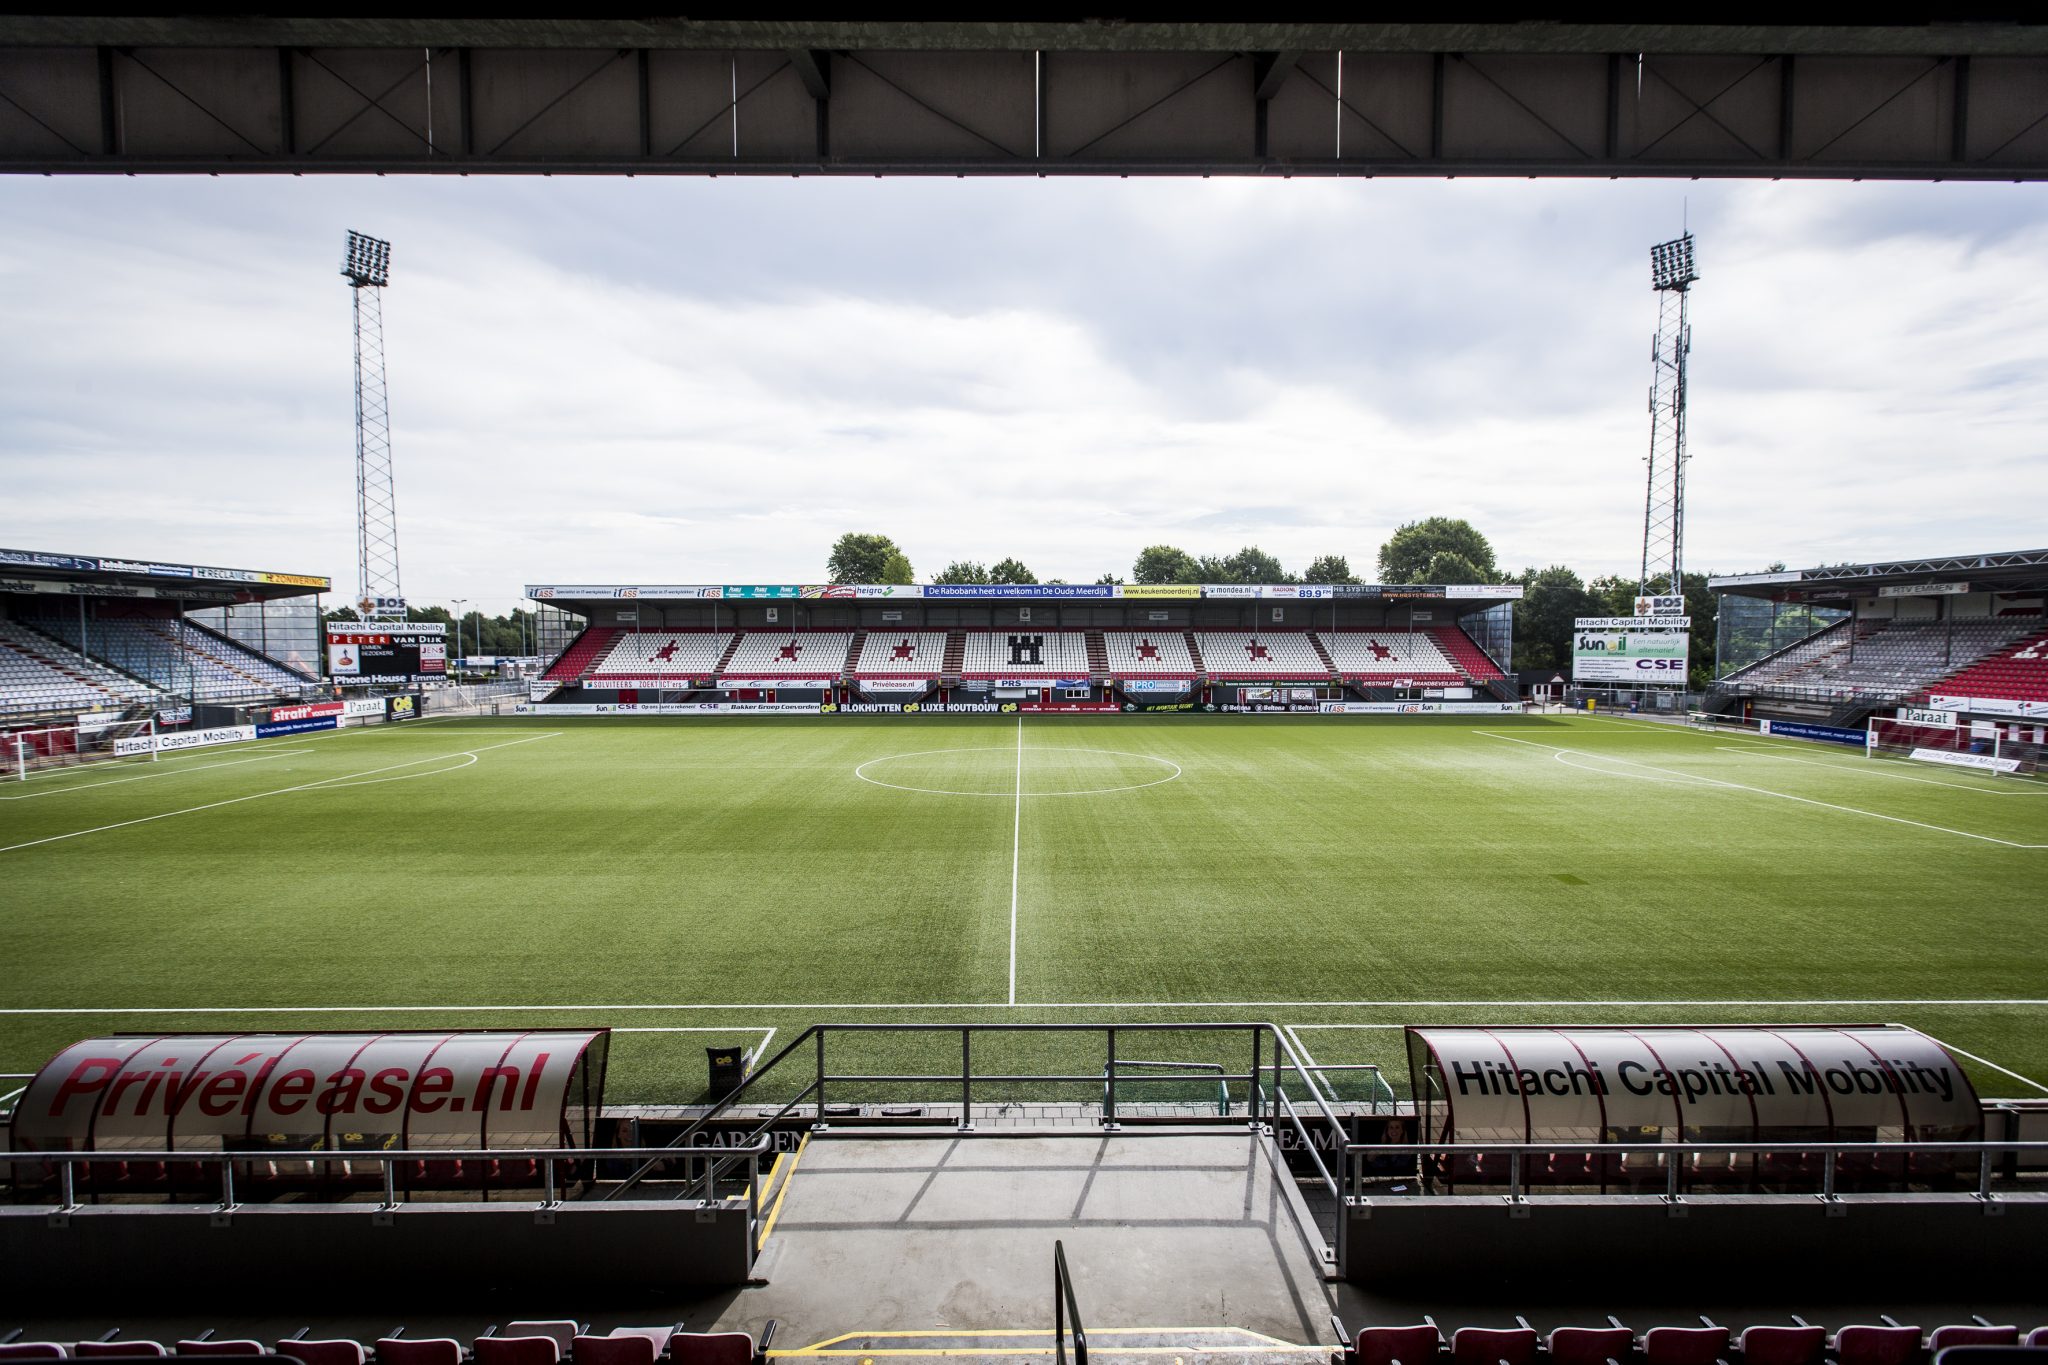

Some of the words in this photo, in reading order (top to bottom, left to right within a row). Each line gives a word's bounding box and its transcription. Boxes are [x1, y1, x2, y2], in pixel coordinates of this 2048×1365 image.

[34, 553, 72, 565] Emmen
[276, 574, 323, 586] ZONWERING
[856, 586, 882, 596] heigro
[929, 587, 940, 595] De
[941, 587, 977, 595] Rabobank
[979, 587, 996, 595] heet
[1003, 587, 1032, 595] welkom
[1033, 587, 1041, 595] in
[1042, 587, 1053, 595] De
[1054, 587, 1074, 595] Oude
[1076, 587, 1108, 596] Meerdijk
[1124, 586, 1199, 596] www.keukenboerderij.nl
[1216, 586, 1251, 594] mondea.nl
[1892, 584, 1914, 595] RTV
[1914, 583, 1954, 594] EMMEN
[377, 598, 406, 608] BOS
[1653, 598, 1682, 608] BOS
[328, 622, 366, 631] Hitachi
[368, 622, 404, 633] Capital
[406, 623, 444, 633] Mobility
[1611, 618, 1645, 627] Capital
[1648, 618, 1689, 627] Mobility
[418, 635, 442, 643] DIJK
[1646, 638, 1680, 647] natuurlijk
[421, 646, 444, 654] JENS
[1635, 659, 1683, 670] CSE
[410, 674, 447, 683] Emmen
[1135, 681, 1155, 689] PRO
[350, 700, 382, 713] Paraat
[840, 703, 900, 712] BLOKHUTTEN
[921, 703, 944, 712] LUXE
[947, 703, 999, 712] HOUTBOUW
[1906, 708, 1948, 724] Paraat
[115, 738, 158, 753] Hitachi
[161, 732, 201, 749] Capital
[203, 729, 244, 743] Mobility
[1943, 753, 1977, 765] Capital
[48, 1053, 551, 1117] Privélease.nl
[1451, 1060, 1610, 1097] Hitachi
[1617, 1060, 1776, 1105] Capital
[1776, 1060, 1954, 1103] Mobility
[690, 1131, 804, 1153] GAREN
